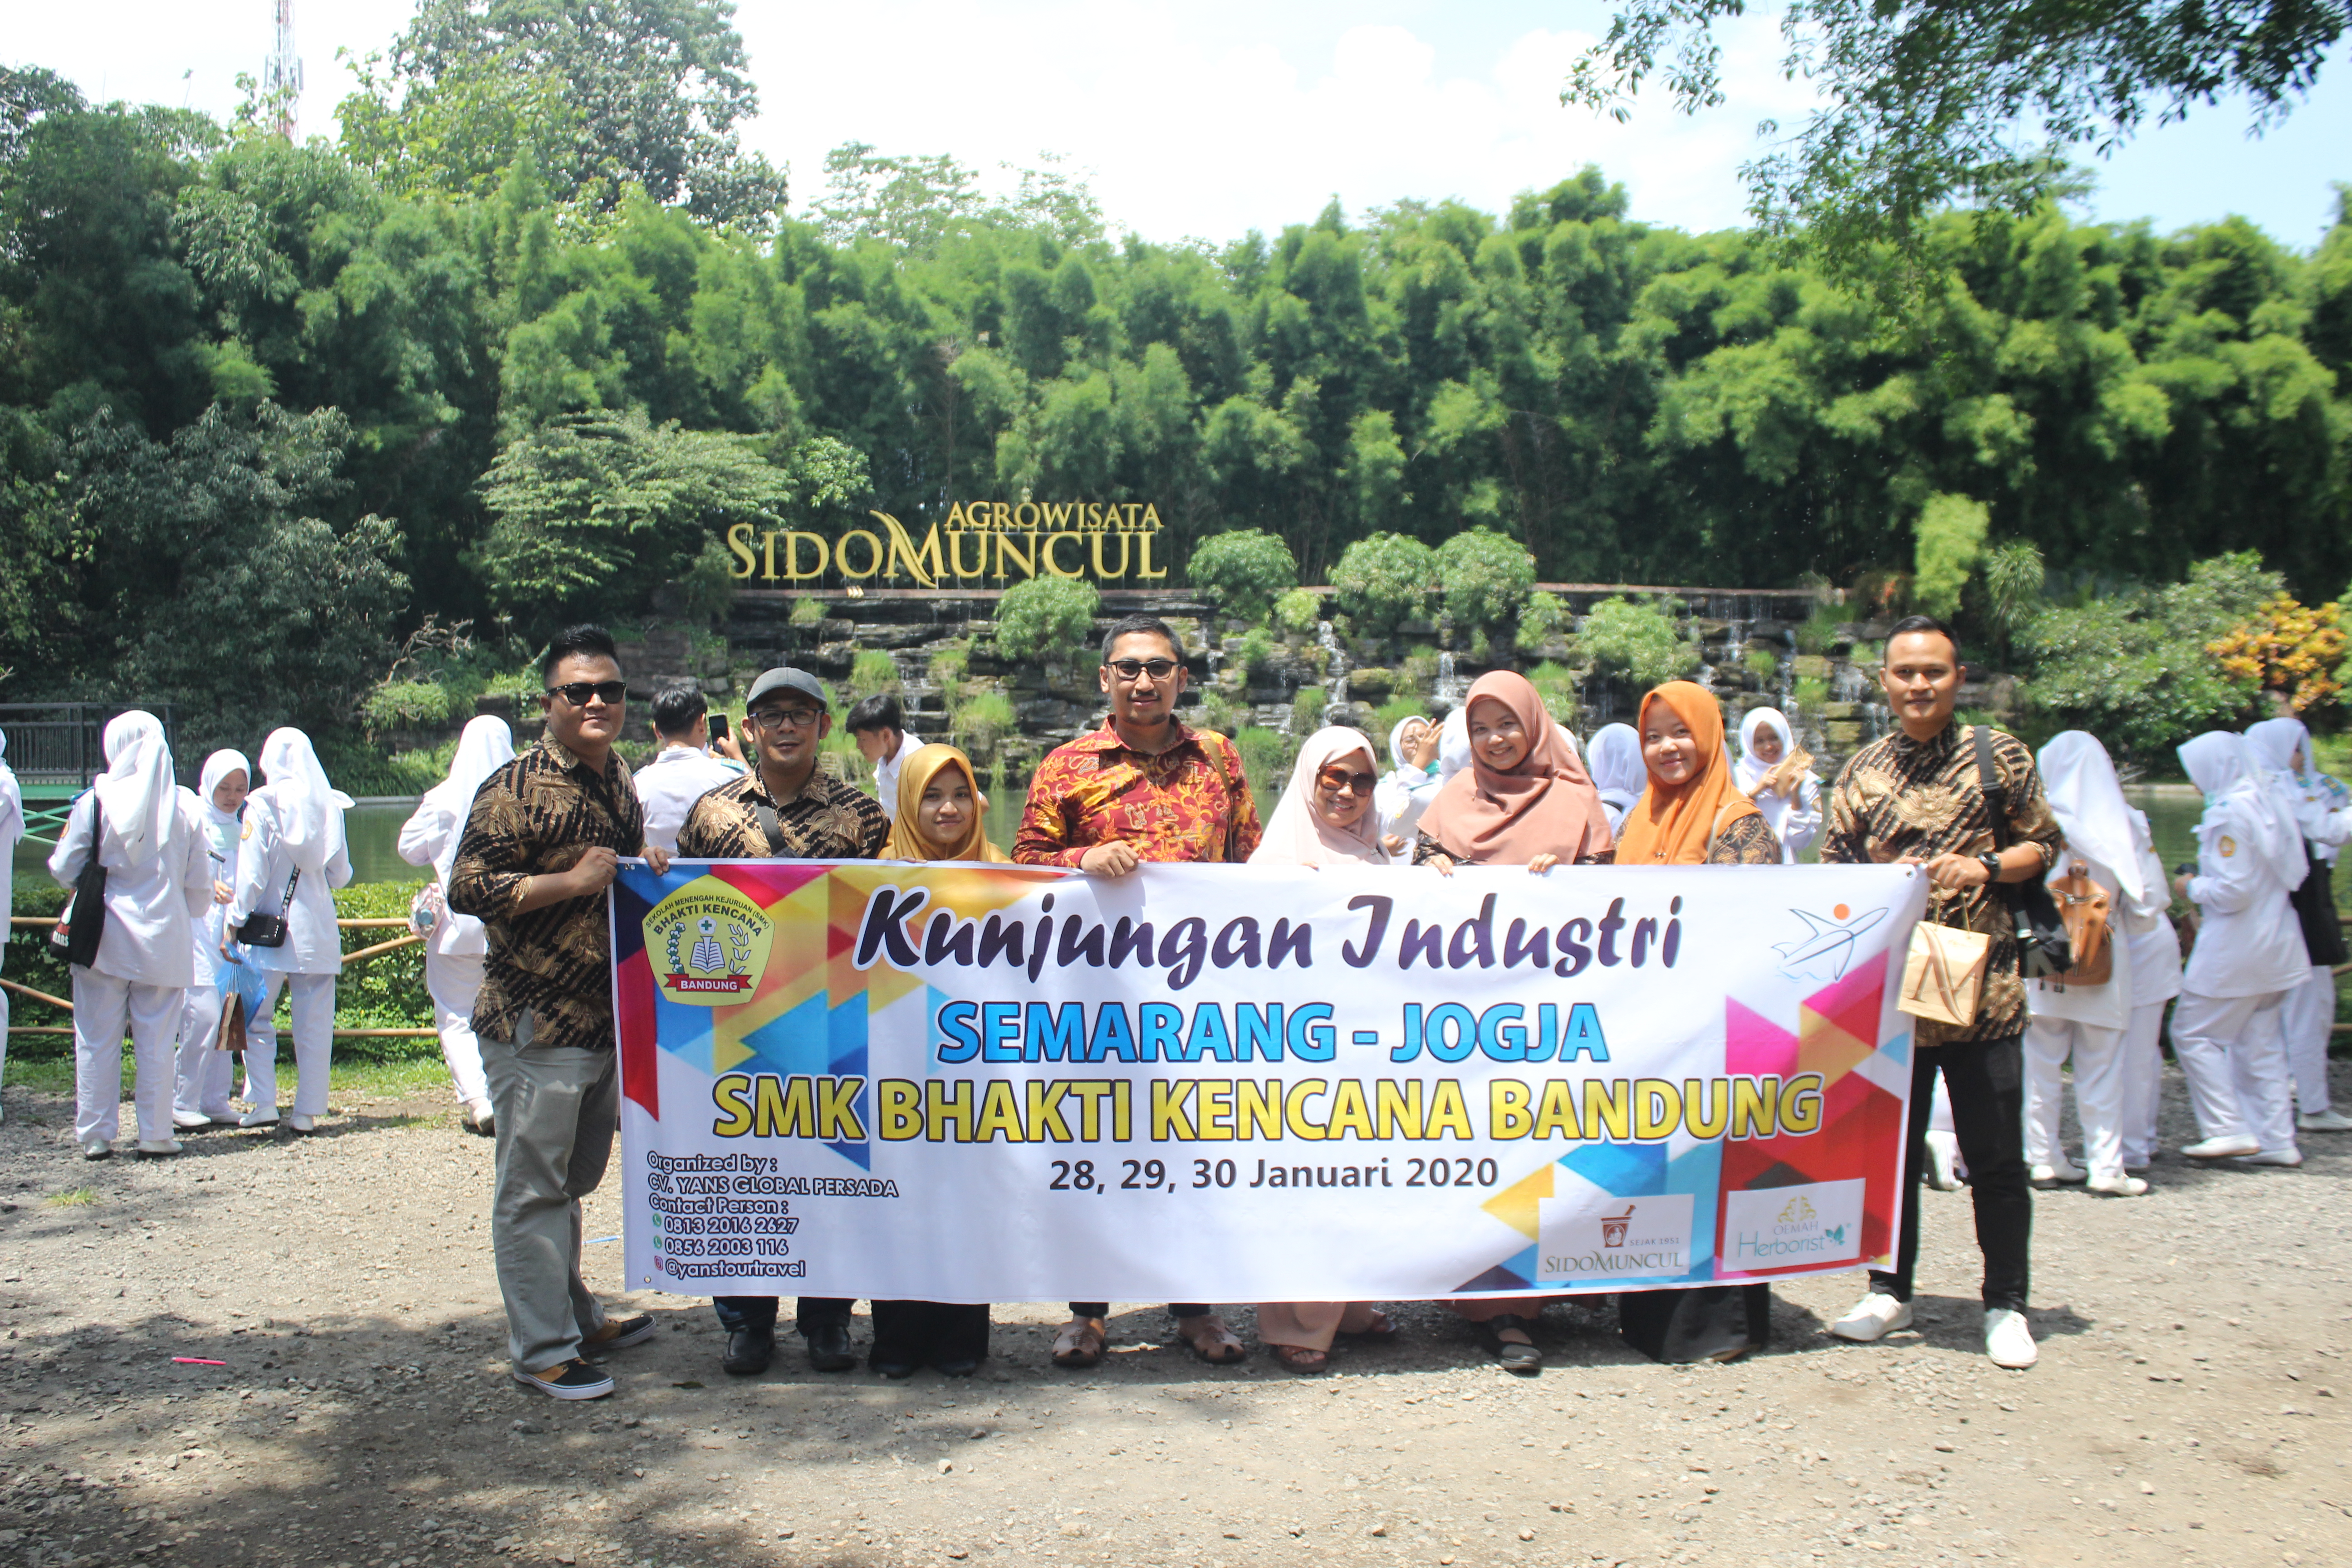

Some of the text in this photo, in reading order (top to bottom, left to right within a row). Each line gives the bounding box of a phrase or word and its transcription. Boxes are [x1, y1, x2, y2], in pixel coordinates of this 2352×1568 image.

[944, 500, 1164, 531] AGROWISATA
[646, 895, 770, 930] SEKOLAH MENENGAH KEJURUAN (SMK)
[653, 904, 763, 937] BHAKTI KENCANA
[858, 889, 1683, 990] Kunjungan Industri
[681, 980, 738, 990] BANDUNG
[937, 1000, 1337, 1063] SEMARANG
[1390, 1001, 1611, 1063] JOGJA
[712, 1075, 1823, 1143] SMK BHAKTI KENCANA BANDUNG
[647, 1151, 737, 1175] Organized
[740, 1154, 768, 1175] by
[1049, 1156, 1499, 1194] 28, 29, 30 Januari 2020
[648, 1173, 899, 1197] CV. YANS GLOBAL PERSADA
[649, 1193, 715, 1215] Contact
[716, 1197, 779, 1214] Person
[664, 1216, 799, 1235] 0813 2016 2627
[1774, 1221, 1819, 1235] OEMAH
[664, 1237, 789, 1256] 0856 2003 116
[1738, 1231, 1825, 1258] Herborist
[665, 1259, 806, 1279] @yanstourtravel
